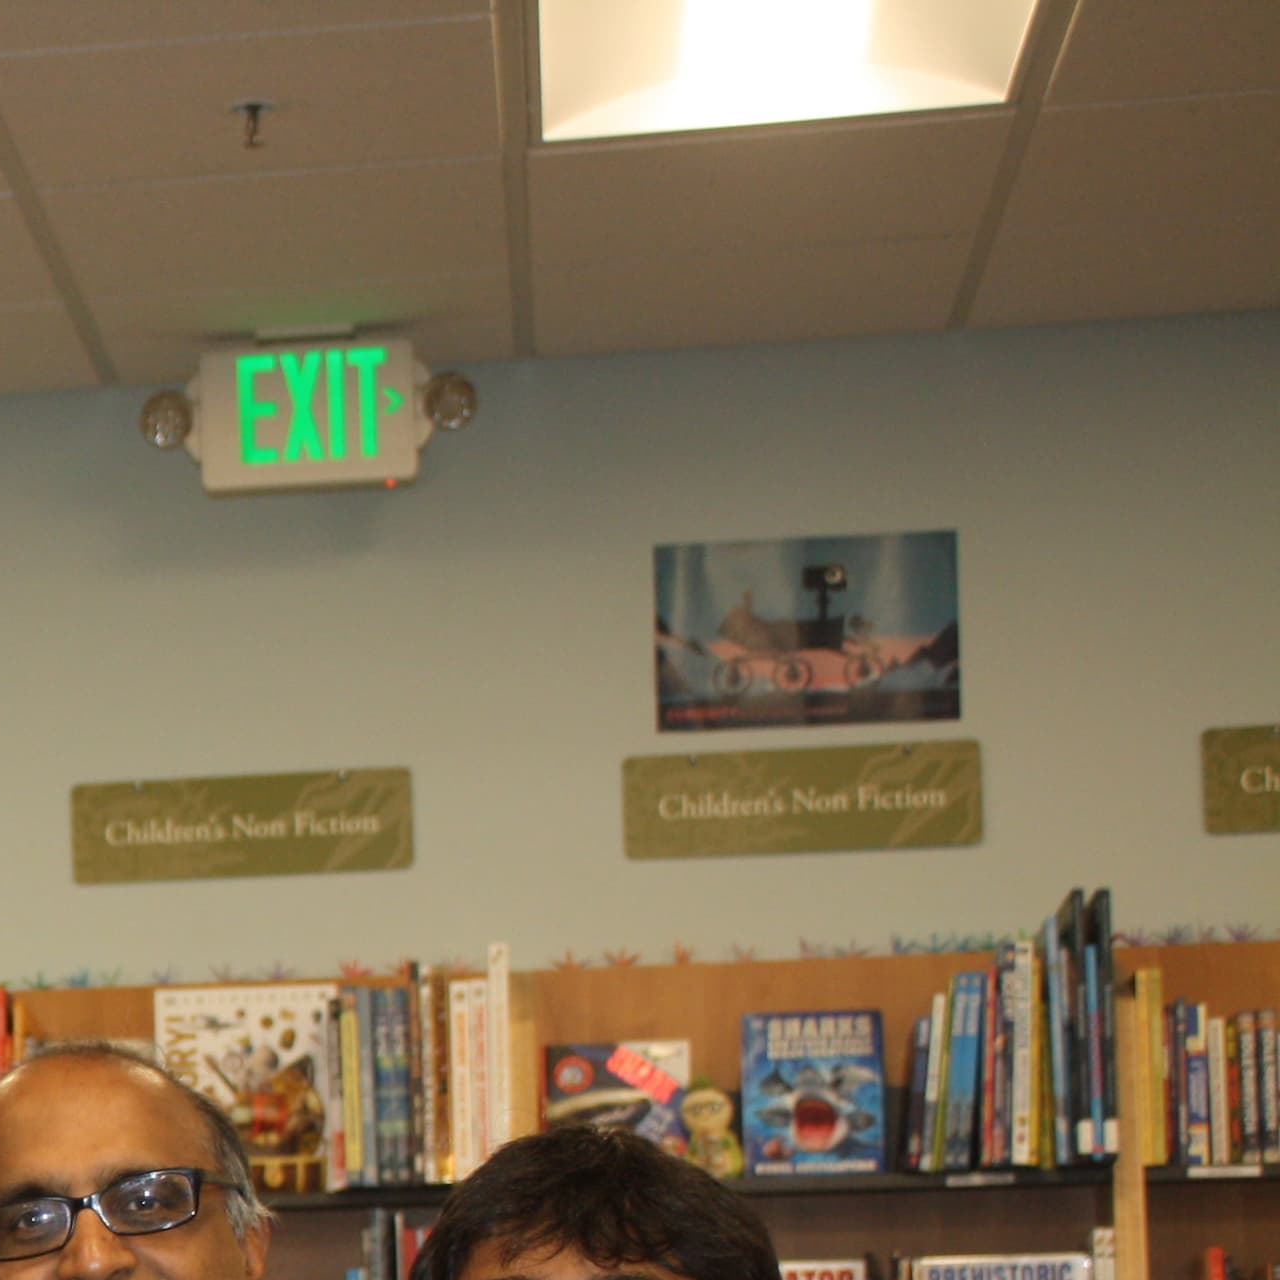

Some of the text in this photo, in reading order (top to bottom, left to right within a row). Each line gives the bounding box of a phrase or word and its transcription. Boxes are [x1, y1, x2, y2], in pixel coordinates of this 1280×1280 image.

[236, 346, 387, 464] EXIT
[1240, 765, 1280, 794] Ch
[658, 783, 948, 820] Children's Non Fiction
[105, 809, 381, 846] Children's Non Fiction
[768, 1015, 873, 1041] SHARKS
